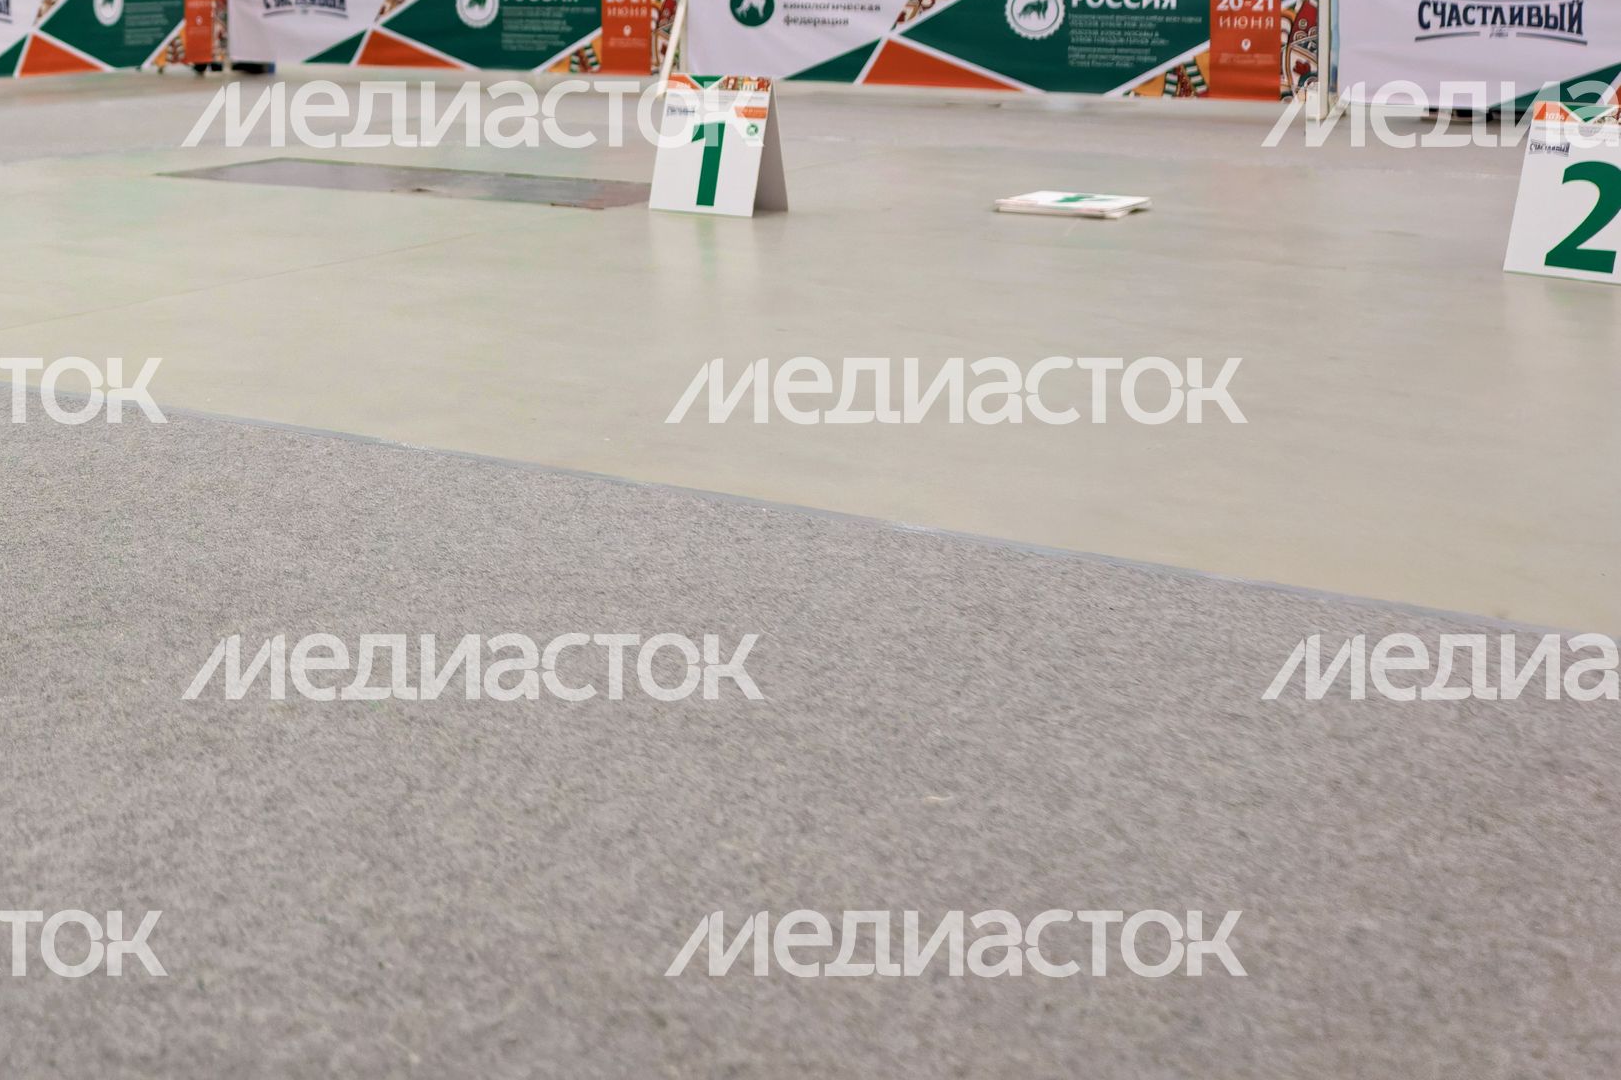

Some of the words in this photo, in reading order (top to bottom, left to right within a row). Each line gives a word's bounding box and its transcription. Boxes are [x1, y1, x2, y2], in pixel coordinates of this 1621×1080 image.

[1218, 15, 1275, 30] ИЮНЯ
[691, 120, 726, 207] 1
[1544, 160, 1621, 274] 2
